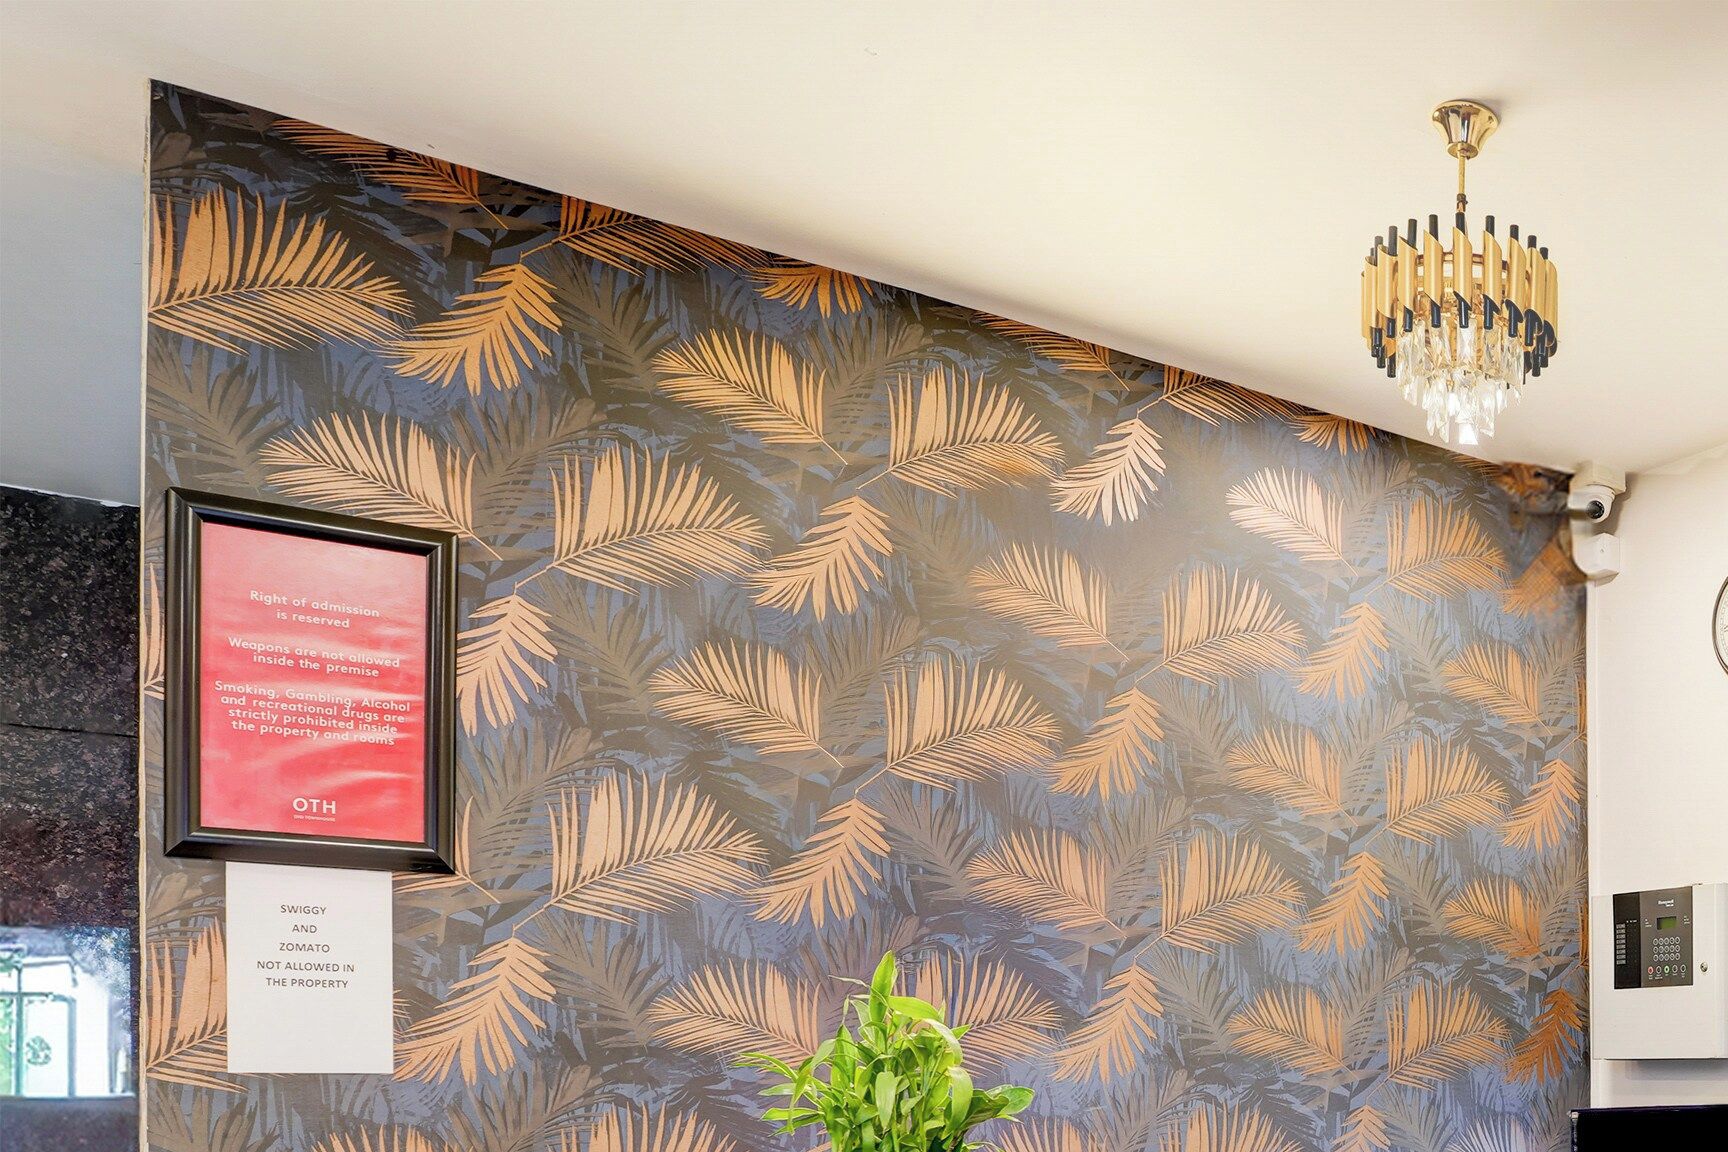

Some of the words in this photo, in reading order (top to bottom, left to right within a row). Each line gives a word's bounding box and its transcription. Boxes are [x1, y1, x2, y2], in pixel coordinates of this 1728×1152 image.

[250, 590, 288, 605] Right
[293, 598, 307, 607] of
[311, 601, 380, 617] admission
[277, 609, 288, 620] is
[292, 613, 350, 628] reserved
[228, 636, 290, 655] Weapons
[295, 648, 317, 657] are
[322, 650, 344, 661] not
[349, 653, 400, 667] allowed
[253, 653, 294, 667] inside
[300, 659, 320, 670] the
[326, 663, 380, 677] premise
[215, 681, 280, 699] Smoking,
[285, 689, 356, 707] Gambling,
[361, 698, 411, 712] Alcohol
[220, 695, 246, 706] and
[252, 699, 337, 716] recreational
[342, 705, 379, 723] drugs
[383, 714, 405, 723] are
[228, 709, 278, 723] strictly
[283, 715, 354, 729] prohibited
[358, 723, 397, 735] inside
[232, 720, 255, 731] the
[260, 724, 319, 740] property
[324, 731, 349, 741] and
[353, 733, 395, 746] rooms
[293, 798, 336, 814] OTH
[280, 905, 327, 915] SWIGGY
[292, 924, 317, 933] AND
[280, 943, 330, 953] ZOMATO
[257, 961, 281, 969] NOT
[285, 962, 339, 972] ALLOWED
[266, 978, 287, 986] THE
[291, 979, 348, 988] PROPERTY
